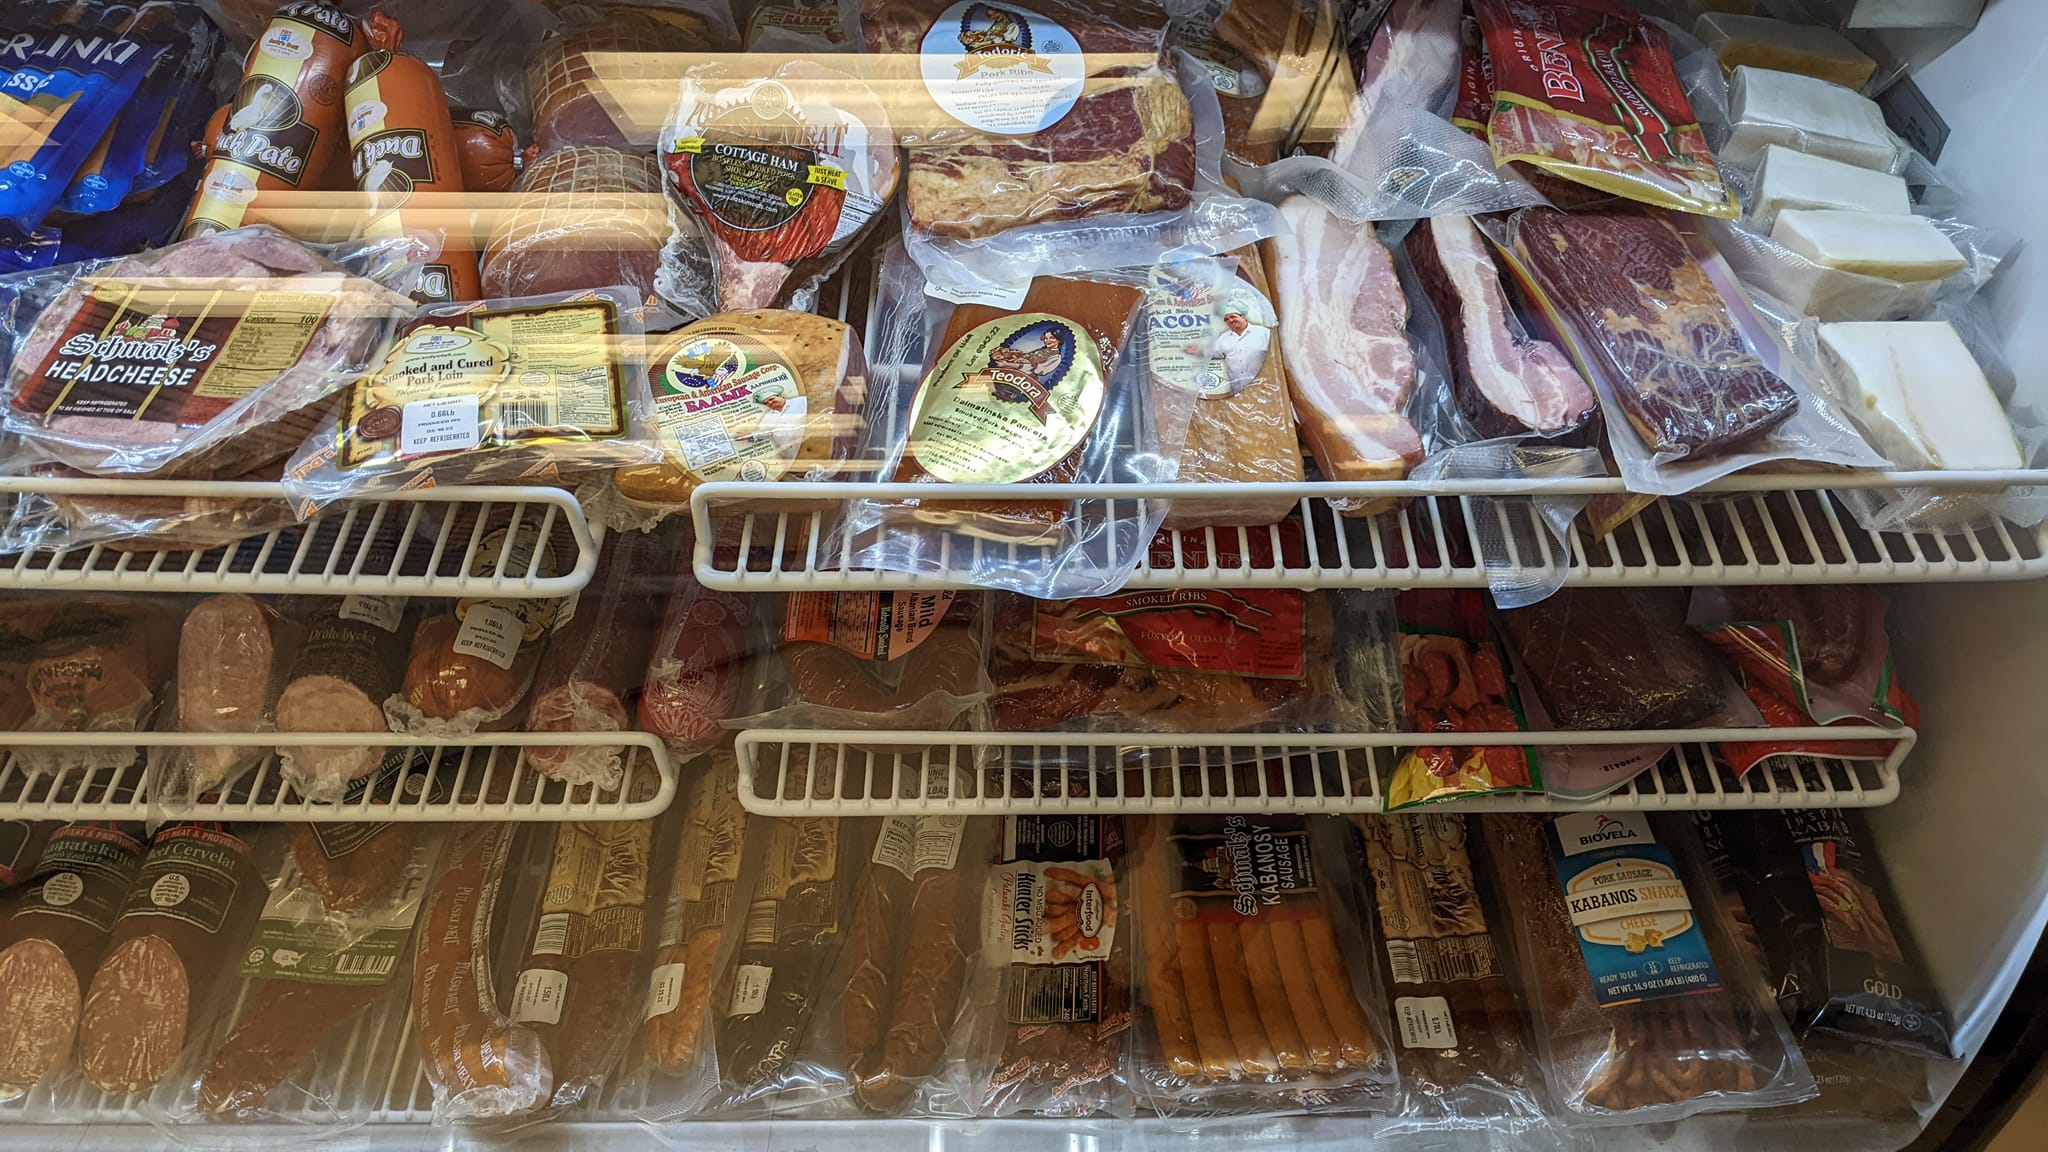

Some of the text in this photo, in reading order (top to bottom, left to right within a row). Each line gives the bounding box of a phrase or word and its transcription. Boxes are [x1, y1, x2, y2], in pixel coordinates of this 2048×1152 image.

[216, 129, 302, 174] uck Pate
[362, 134, 423, 161] Duck
[714, 143, 769, 164] COTTAGE
[770, 159, 799, 172] HAM
[814, 167, 828, 176] JUST
[841, 211, 861, 222] Calories
[244, 315, 319, 324] Calories 100
[1150, 314, 1211, 329] ACON
[59, 332, 216, 364] Schmalz's
[45, 360, 197, 387] HEADCHEESE
[381, 355, 494, 386] Smoked and Cured
[406, 370, 464, 387] Pork Loin
[654, 392, 691, 405] European
[699, 381, 734, 398] American
[733, 373, 762, 389] Sausage
[760, 363, 780, 376] Corp.
[990, 369, 1042, 399] Teodora
[684, 384, 752, 414] БАЛЫК
[430, 409, 456, 418] 0.66Lb
[413, 431, 471, 445] KEEP REFRIGERATED
[918, 594, 936, 628] Mild
[1125, 591, 1208, 608] SMOKED RIBS
[894, 600, 907, 632] Sausage
[905, 622, 916, 644] Brand
[192, 829, 199, 837] &
[1579, 829, 1637, 846] BIOVELA
[172, 842, 236, 872] Cervelat
[1223, 815, 1259, 917] Schmalz's
[1251, 824, 1281, 906] KABANOSY
[1274, 837, 1296, 889] SAUSAGE
[1592, 868, 1653, 886] PORK SAUSAGE
[449, 886, 474, 922] PULASKI
[1015, 872, 1036, 915] Hunter
[1571, 888, 1638, 914] KABANOS
[1638, 885, 1684, 901] SNACK
[1034, 886, 1044, 944] NO MSG ADDED
[1084, 889, 1094, 932] Interfood
[1619, 915, 1658, 930] CHEESE
[1013, 918, 1034, 951] Sticks
[1667, 956, 1681, 966] KEEP
[1669, 961, 1709, 973] REFRIGERATED
[1599, 974, 1617, 985] READY
[1626, 970, 1638, 980] EAT
[1607, 974, 1708, 996] NET WT. 16.9 OZ (1.06 LB) (480 G)
[1863, 978, 1903, 1001] GOLD
[1063, 1007, 1071, 1020] 240
[1082, 994, 1091, 1011] Facts
[451, 1023, 478, 1090] PULASKI MEAT
[480, 1040, 498, 1071] MEAT
